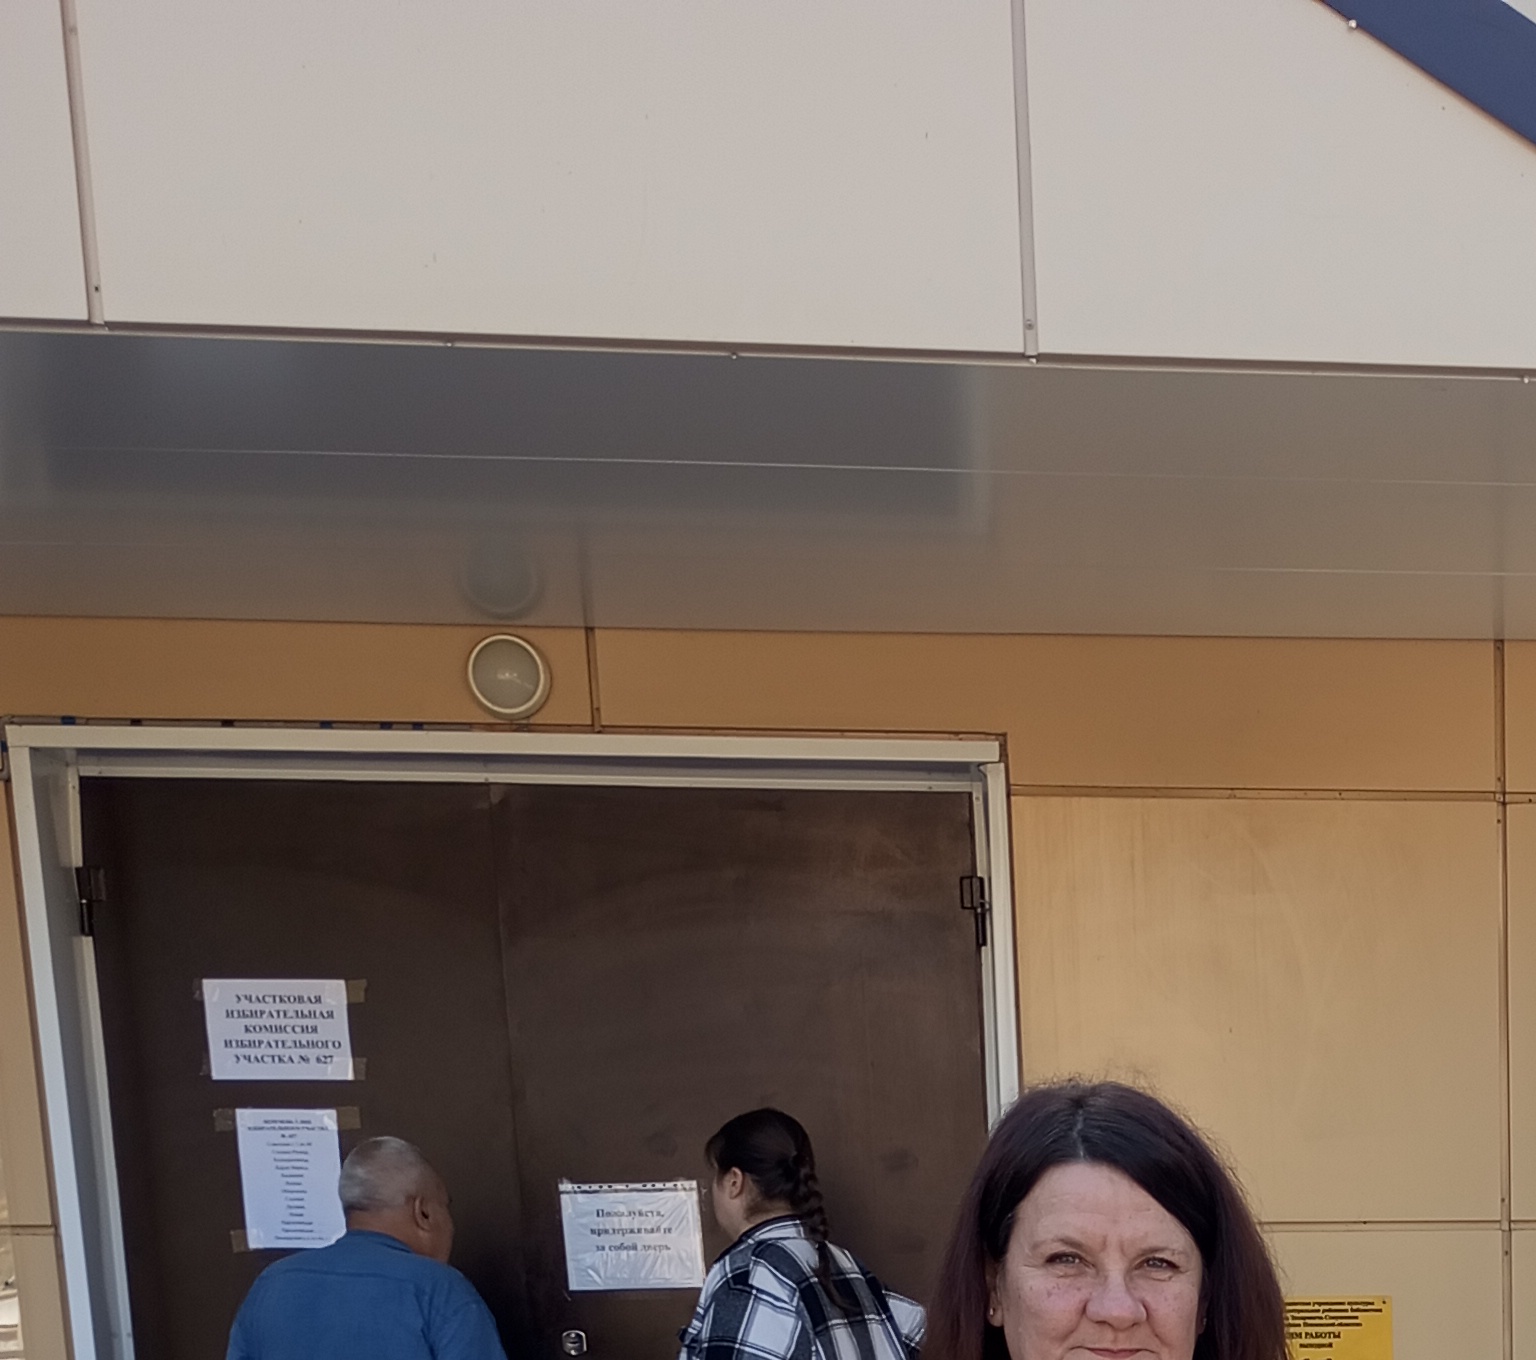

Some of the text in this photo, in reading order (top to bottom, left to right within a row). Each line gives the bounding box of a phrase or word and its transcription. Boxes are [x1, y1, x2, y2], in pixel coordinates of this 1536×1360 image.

[235, 994, 322, 1004] УЧАСТКОВАЯ
[225, 1009, 334, 1019] ИЗБИРАТЕЛЬНАЯ
[244, 1024, 318, 1034] КОМИССИЯ
[224, 1039, 342, 1049] ИЗБИРАТЕЛЬНОГО
[234, 1054, 334, 1064] УЧАСТКА № 627
[608, 1243, 638, 1252] собой
